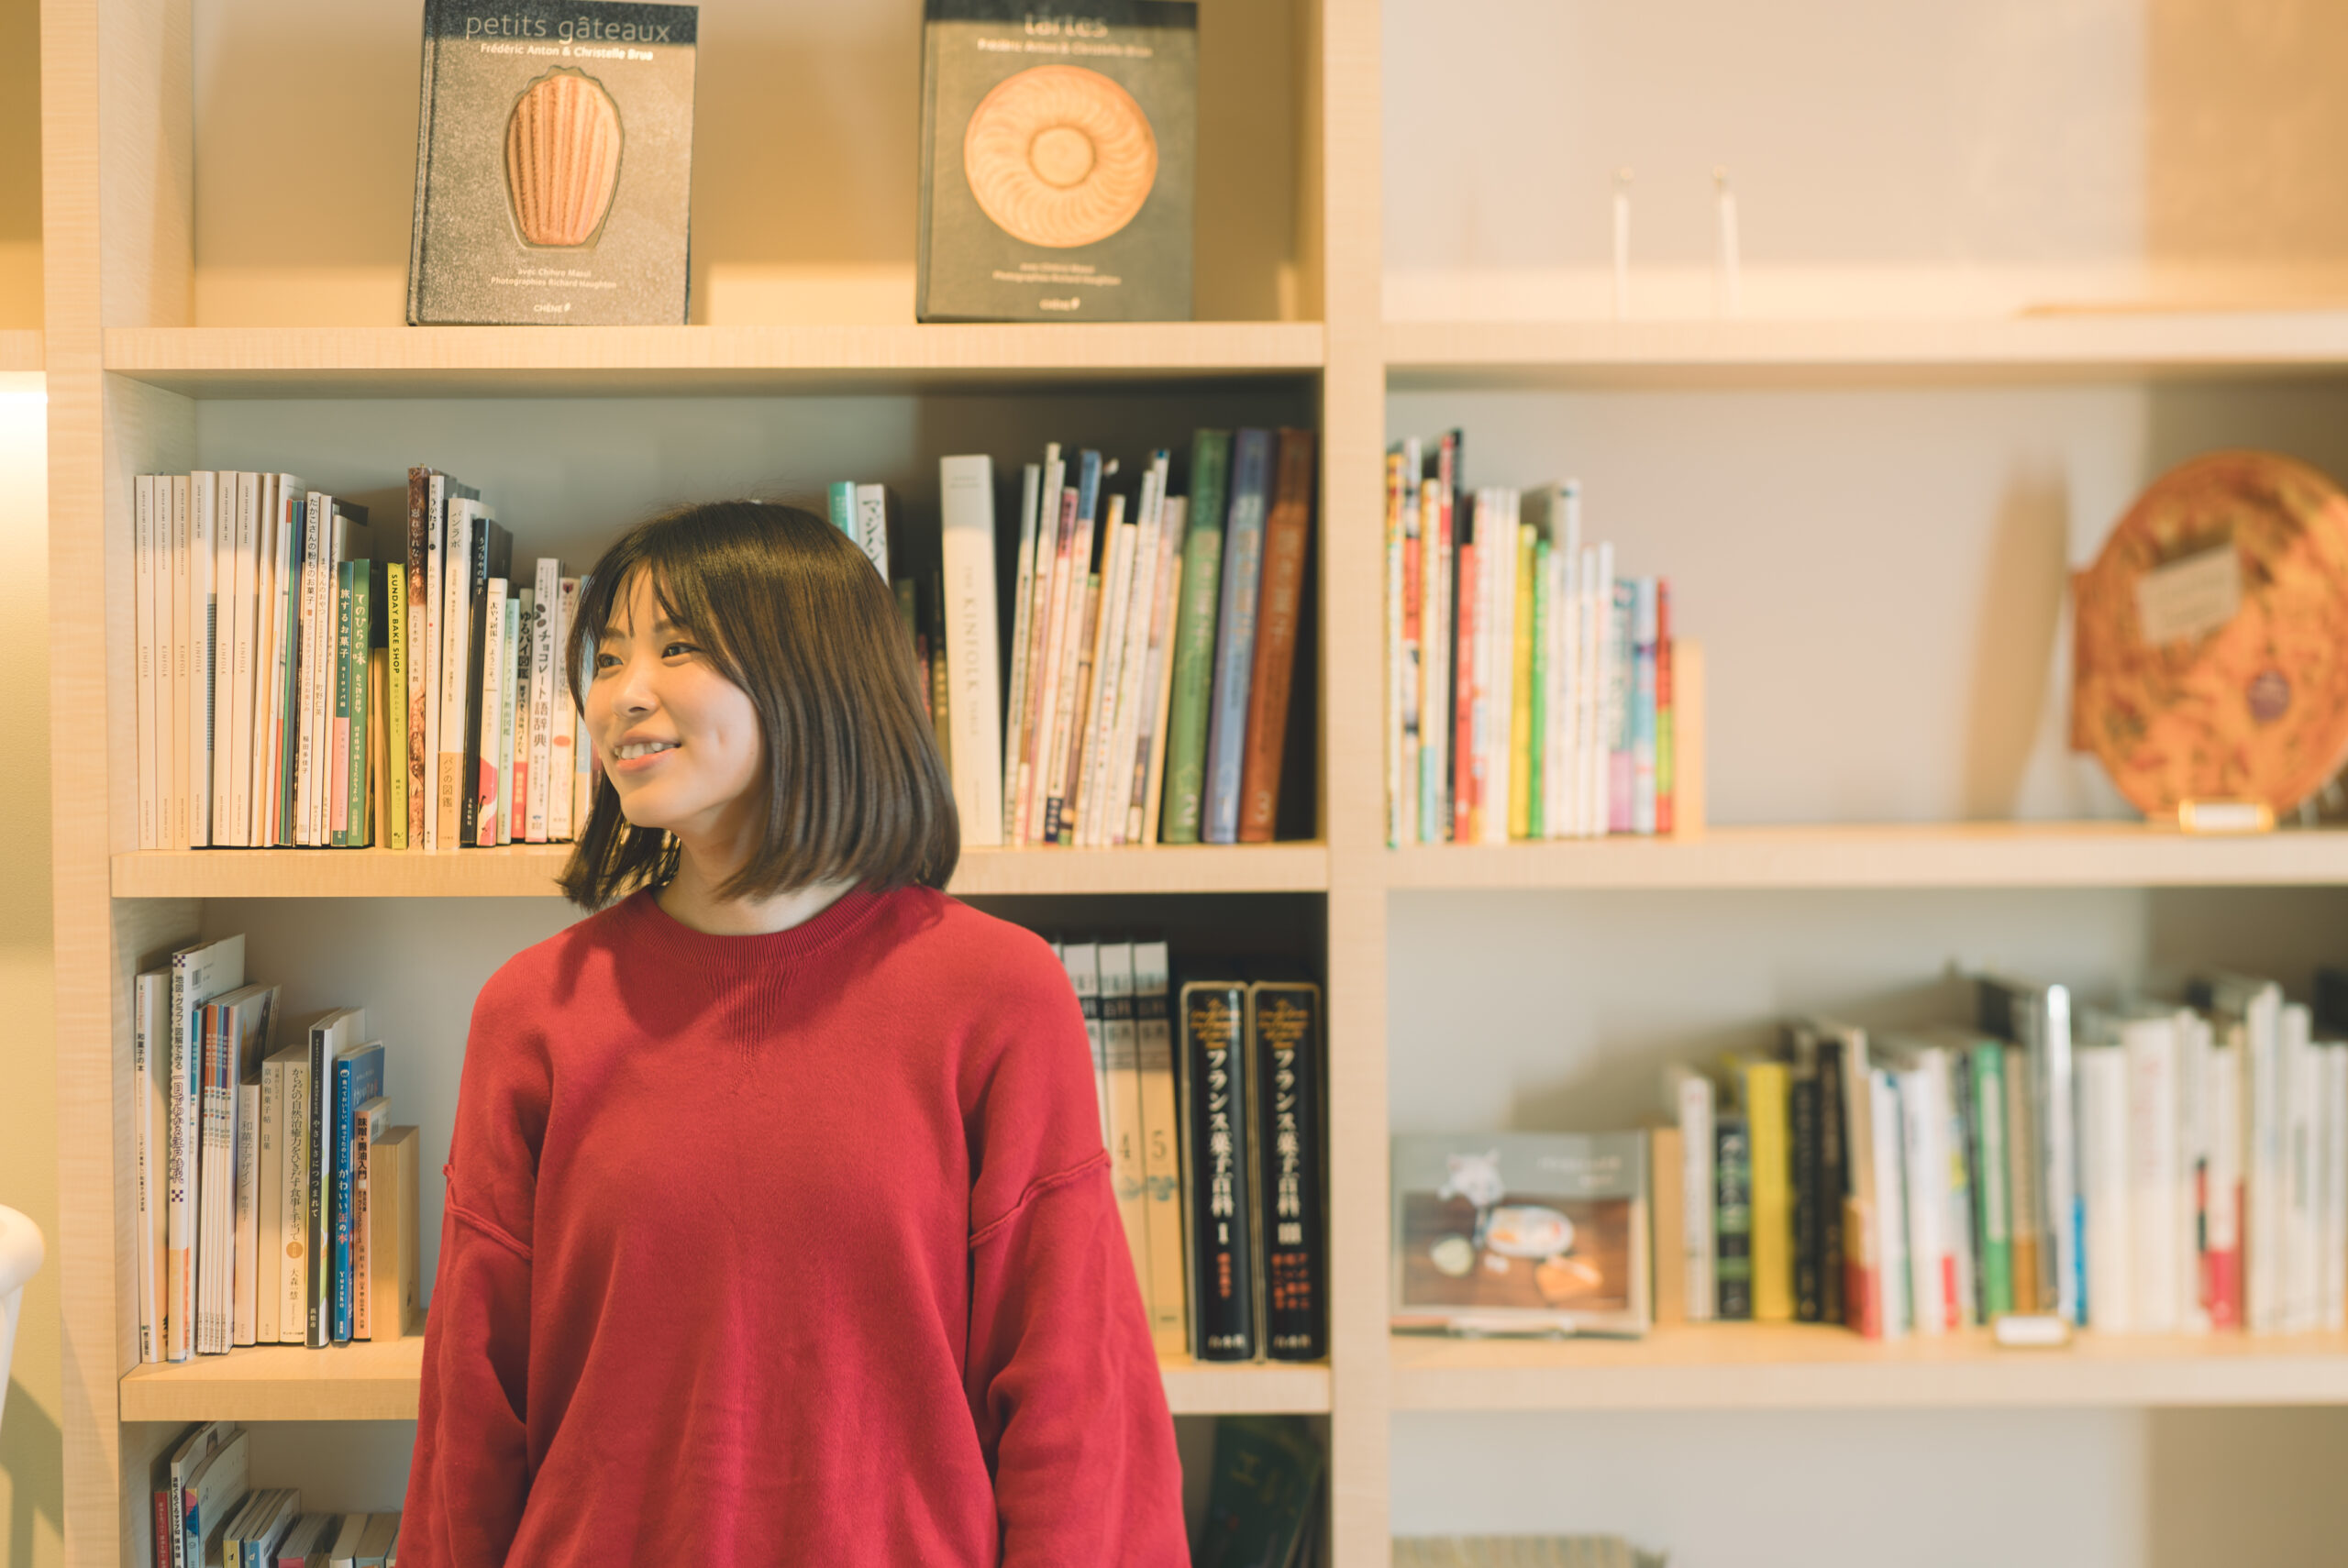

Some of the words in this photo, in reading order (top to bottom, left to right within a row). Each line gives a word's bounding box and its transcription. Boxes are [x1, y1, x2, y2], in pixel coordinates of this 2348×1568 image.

[466, 14, 547, 41] petits
[558, 16, 670, 45] gâteaux
[481, 43, 524, 54] Frédéric
[526, 46, 559, 56] Anton
[562, 47, 570, 57] &
[573, 47, 626, 59] Christelle
[305, 499, 318, 605] たかこさんの粉ものお菓子
[450, 509, 462, 549] パンラボ
[339, 588, 350, 659] 旅するお菓子
[352, 593, 366, 666] てのひらの味
[518, 611, 532, 679] ゆるパイ図鑑
[962, 597, 980, 693] KINFOLK
[534, 629, 551, 747] チョコレート語辞典
[173, 975, 184, 1071] 地図・グラフ・図解でみる
[169, 1075, 184, 1185] 一目でわかる江戸時代
[240, 1121, 253, 1188] 和菓子デザイン
[311, 1119, 321, 1218] やさしさにつつまれて
[1152, 1129, 1167, 1160] 5
[1207, 1049, 1235, 1218] フランス菓子百科
[1276, 1049, 1301, 1218] フランス菓子百科
[337, 1168, 349, 1245] かわいい缶の本
